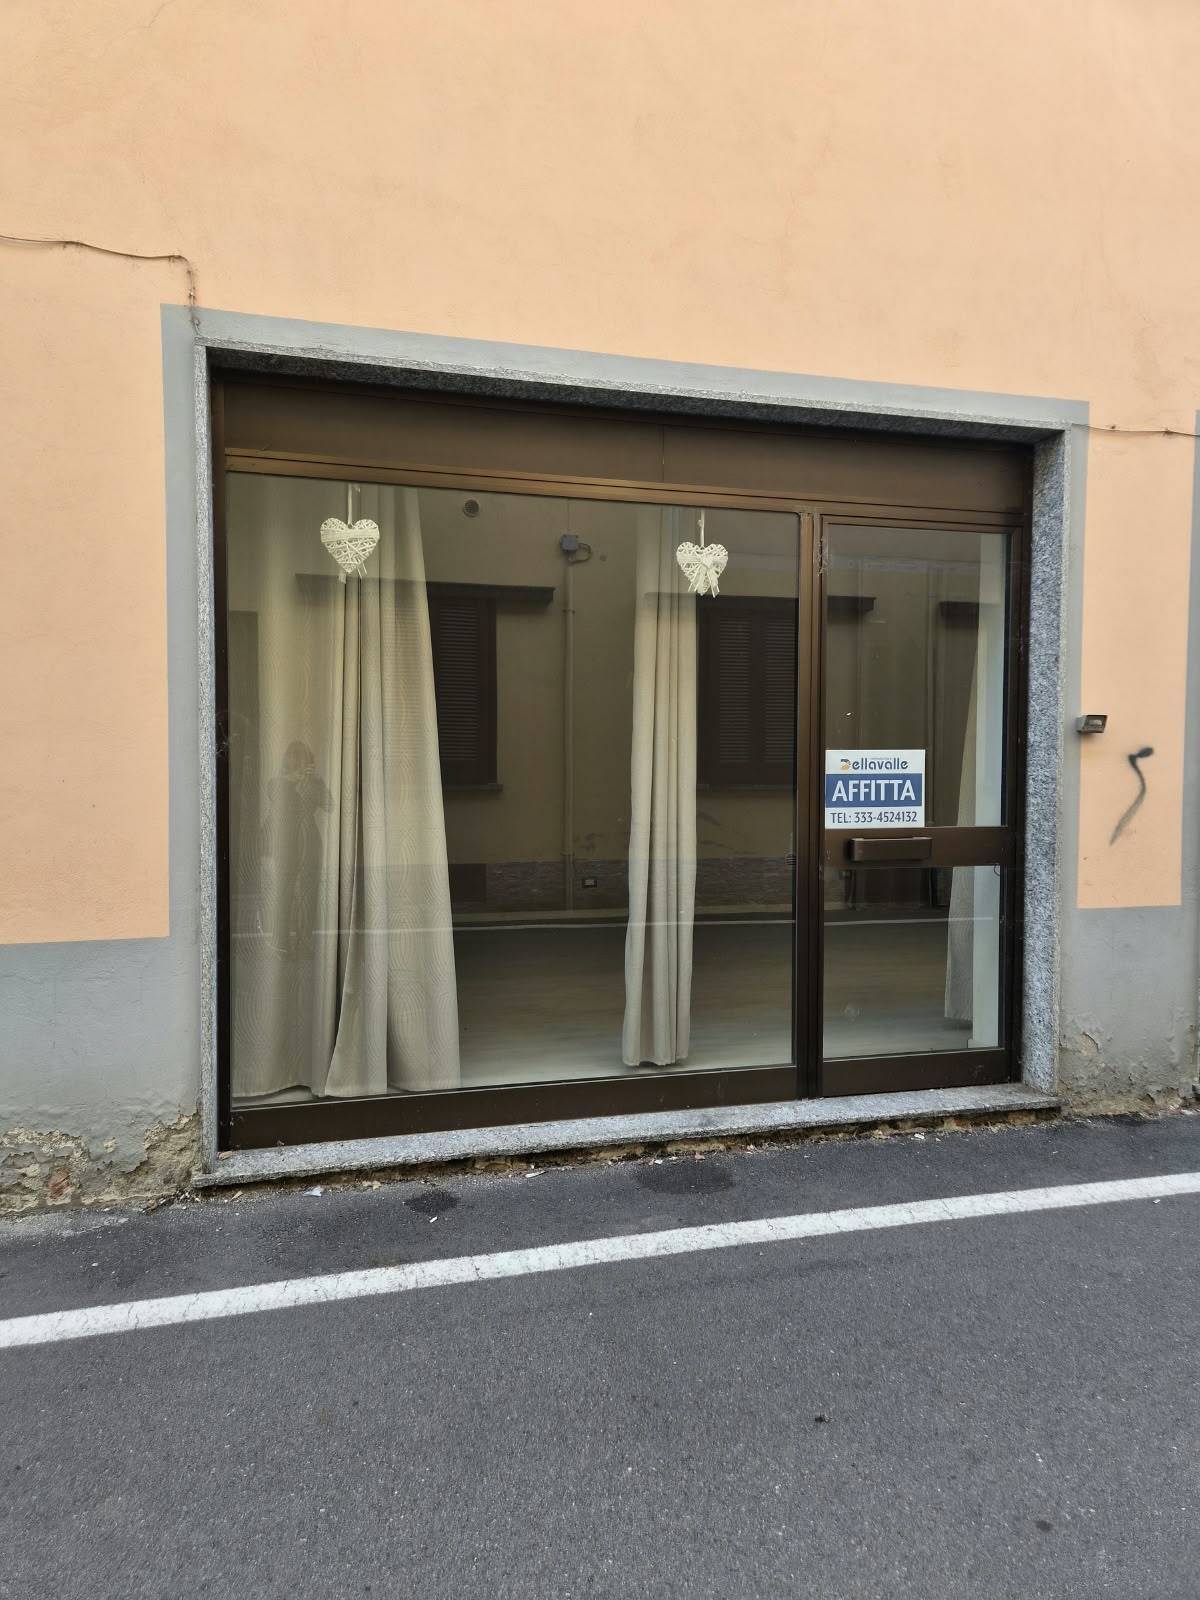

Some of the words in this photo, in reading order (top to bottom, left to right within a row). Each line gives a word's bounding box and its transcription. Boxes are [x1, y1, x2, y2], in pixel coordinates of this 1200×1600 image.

[840, 757, 909, 771] Dellavalle
[831, 779, 916, 802] AFFITTA
[830, 812, 852, 824] TEL:
[854, 811, 918, 824] 333-4524132
